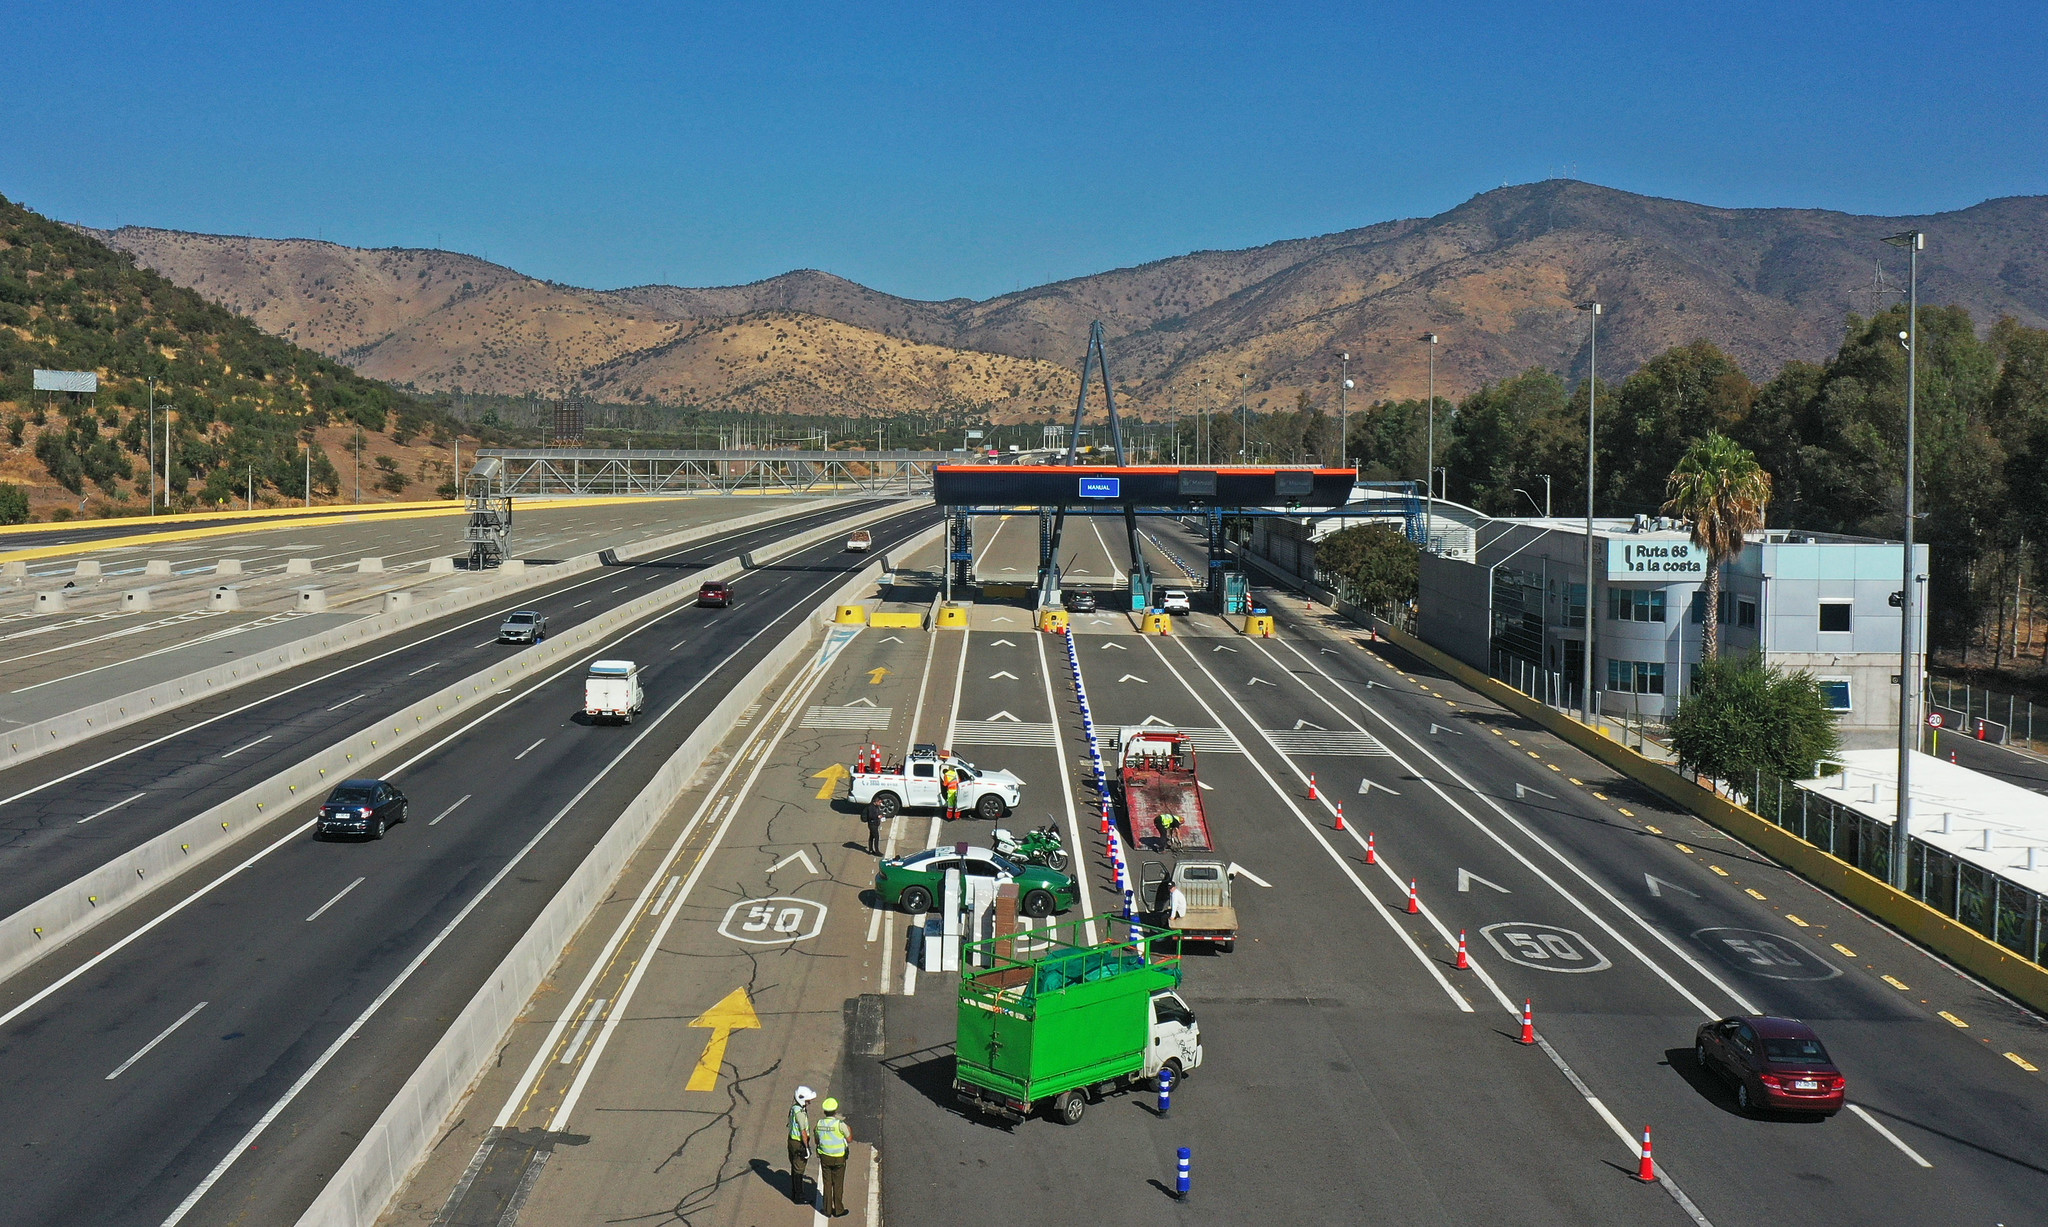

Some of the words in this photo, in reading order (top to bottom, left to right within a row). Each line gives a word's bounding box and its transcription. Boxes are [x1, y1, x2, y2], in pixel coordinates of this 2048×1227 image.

[1636, 545, 1668, 558] Ruta
[1671, 545, 1688, 558] 68
[1635, 561, 1644, 572] a
[1647, 559, 1660, 572] la
[1663, 559, 1701, 572] costa
[1930, 716, 1941, 724] 20
[742, 906, 805, 932] 50
[1503, 932, 1583, 960] 50
